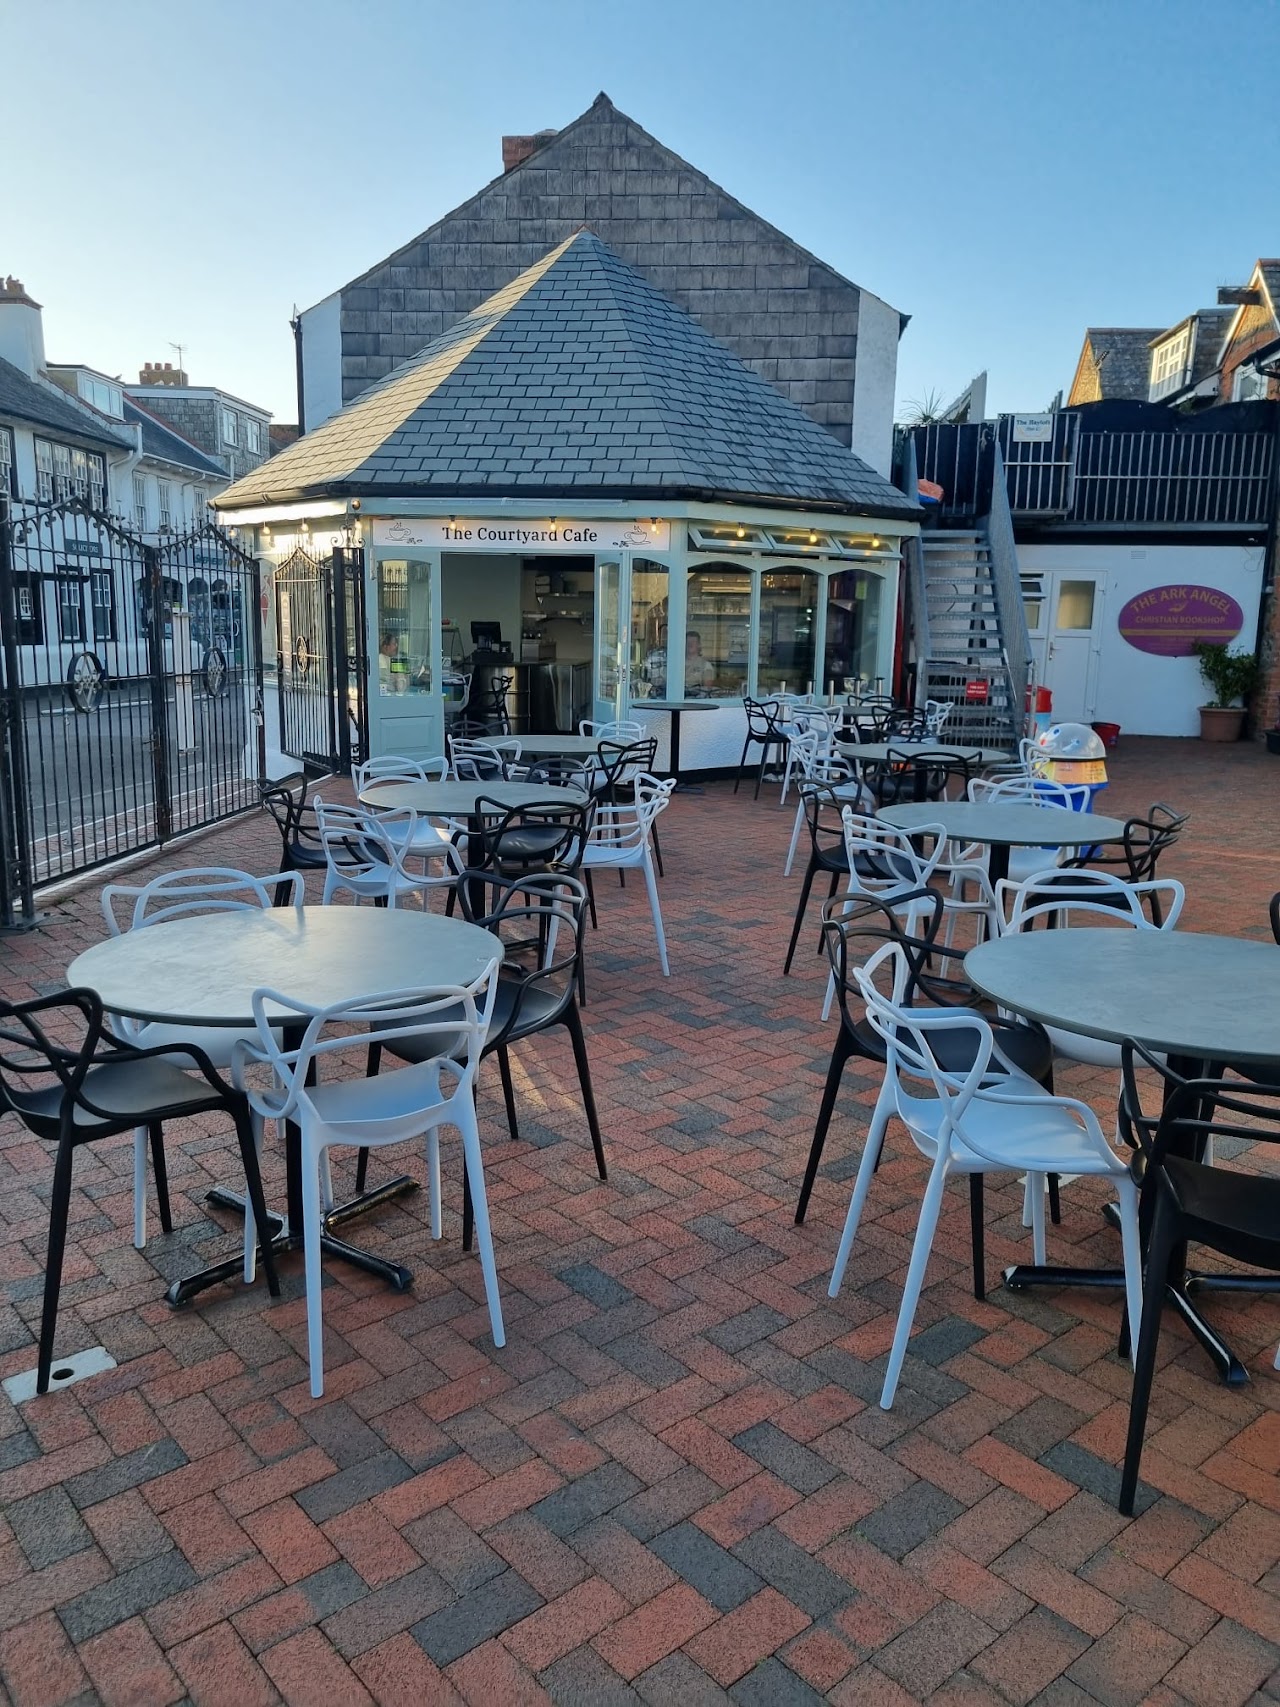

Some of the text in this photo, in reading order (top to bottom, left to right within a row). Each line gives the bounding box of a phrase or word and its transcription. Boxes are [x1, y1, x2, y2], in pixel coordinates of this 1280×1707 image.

[442, 526, 598, 544] The Courtyard Cafe
[72, 543, 99, 553] SLICIORS
[1130, 588, 1233, 615] THE ARK ANGEL
[1135, 615, 1226, 624] CHRISTIAN BOOKSHOP
